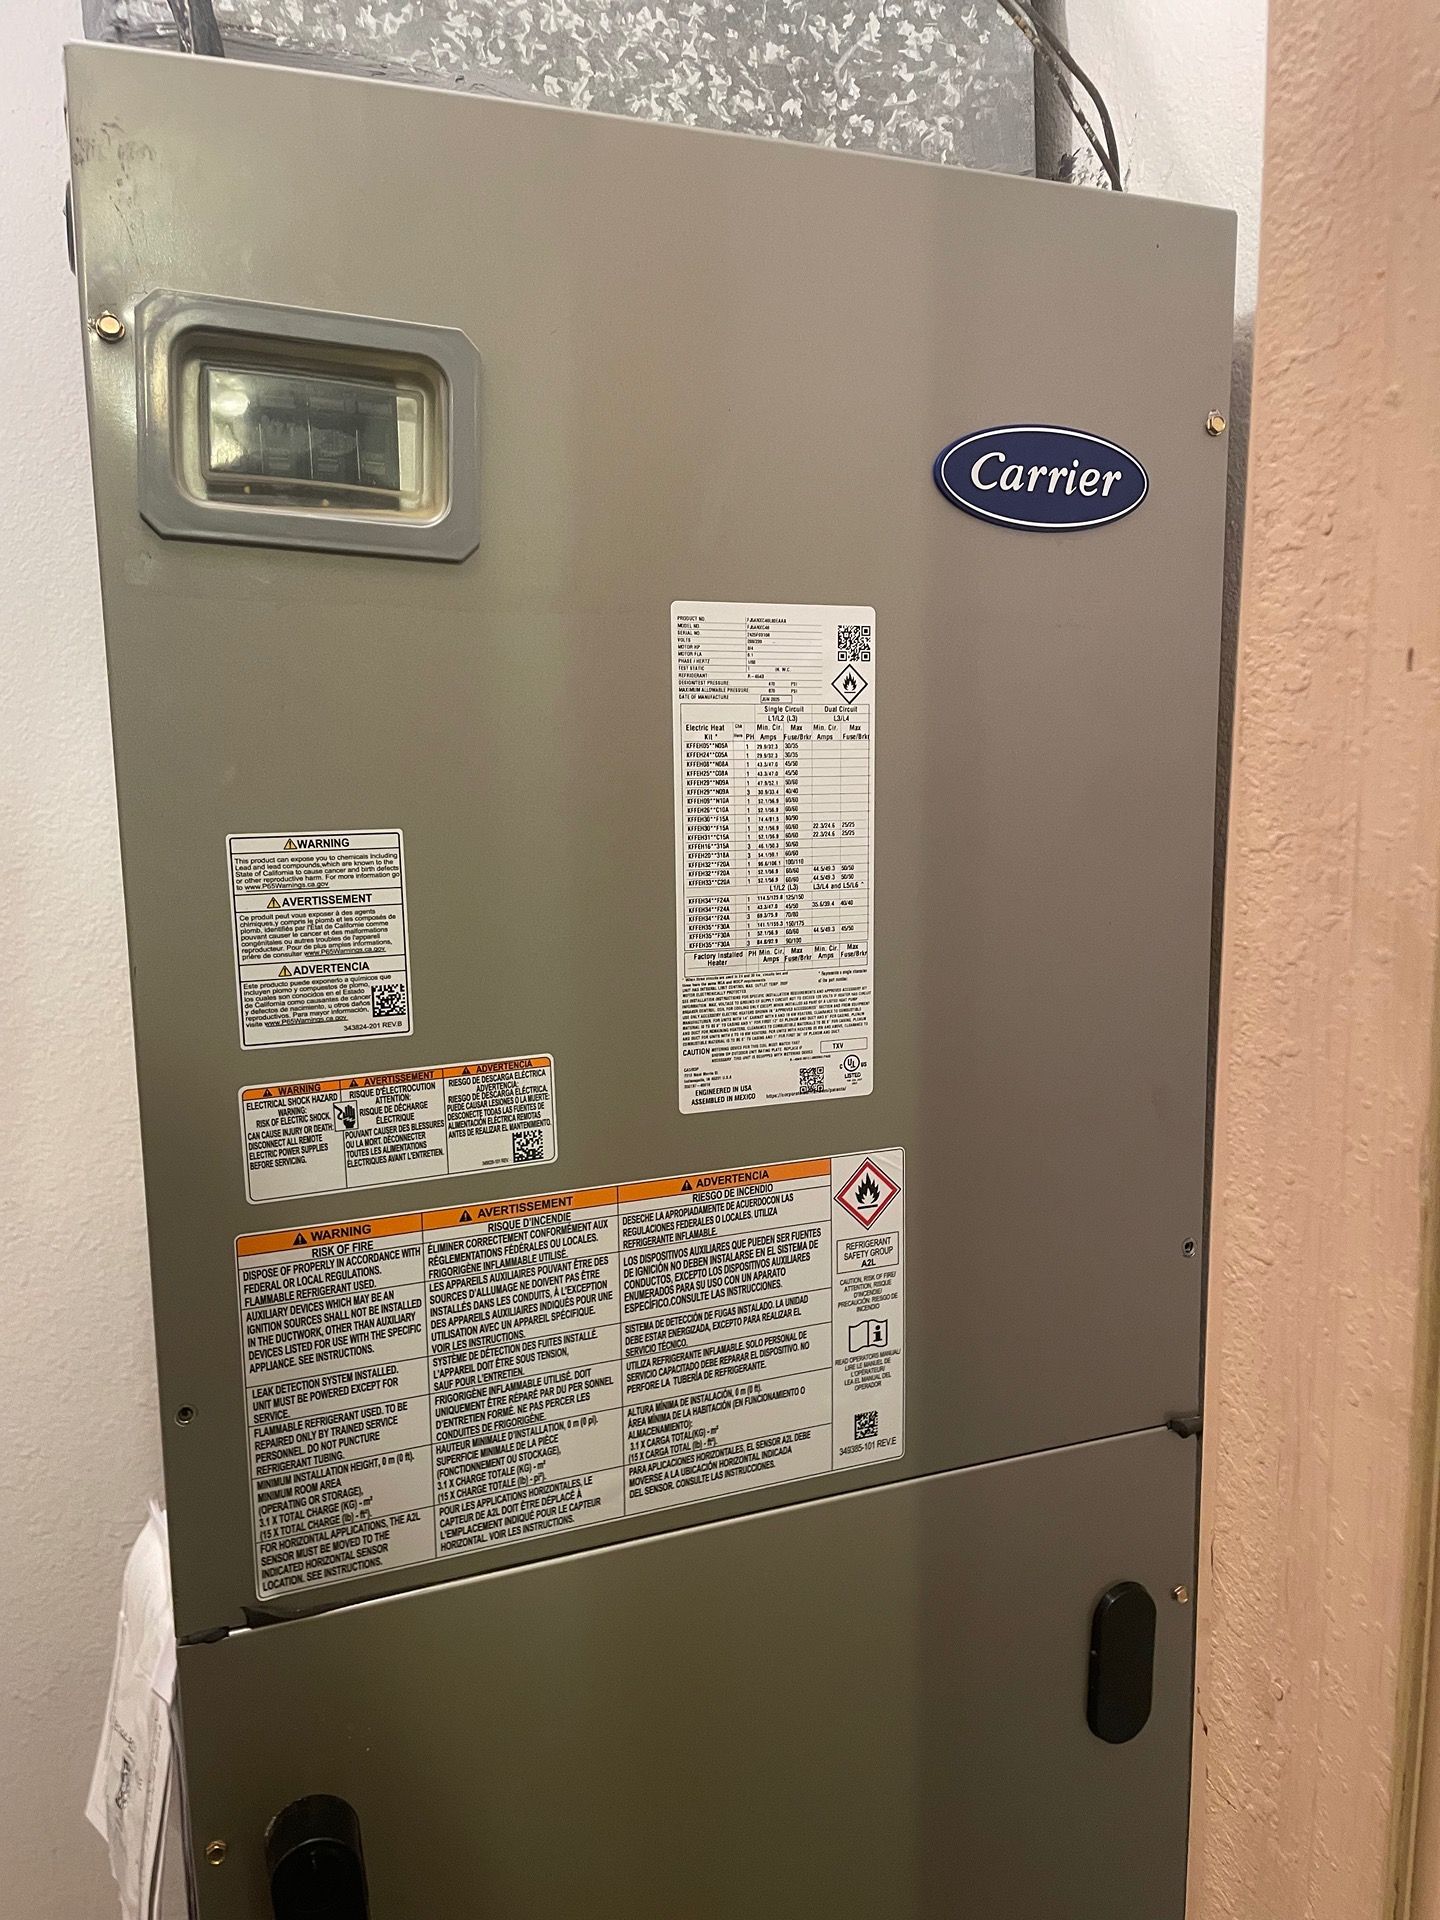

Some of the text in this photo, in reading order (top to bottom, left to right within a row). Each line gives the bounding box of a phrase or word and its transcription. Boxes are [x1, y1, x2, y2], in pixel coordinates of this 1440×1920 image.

[970, 451, 1121, 497] Carrier
[296, 839, 350, 849] WARNING
[234, 857, 249, 865] This
[250, 857, 275, 865] product
[336, 853, 368, 861] chemicals
[369, 852, 398, 861] including
[281, 894, 373, 907] AVERTISSEMENT
[692, 950, 744, 961] Factory Installed
[293, 961, 370, 975] ADVERTENCIA
[682, 1046, 711, 1056] CAUTION
[476, 1060, 533, 1074] ADVERTENCIA
[363, 1070, 435, 1086] AVERTISSEMENT
[448, 1069, 547, 1086] RIESGO DE DESCARGA ELÉCTRICA
[277, 1083, 321, 1095] WARNING
[348, 1081, 436, 1100] RISQUE D'ÉLECTROCUTION
[694, 1084, 753, 1096] ENGINEERED IN USA
[246, 1093, 338, 1110] ELECTRICAL SHOCK HAZARD
[374, 1093, 412, 1104] ATTENTION:
[691, 1095, 725, 1105] ASSEMBLED
[734, 1093, 756, 1101] MEXICO
[277, 1106, 308, 1116] WARNING:
[255, 1119, 270, 1128] RISK
[270, 1118, 279, 1126] OF
[279, 1115, 308, 1125] ELECTRIC
[247, 1131, 260, 1140] CAN
[260, 1129, 281, 1139] CAUSE
[281, 1126, 302, 1136] INJURY
[303, 1125, 312, 1134] OR
[247, 1134, 323, 1150] DISCONNECT ALL REMOTE
[248, 1143, 329, 1160] ELECTRIC POWER SUPPLIES
[249, 1155, 308, 1170] BEFORE SERVICING.
[696, 1170, 770, 1188] ADVERTENCIA
[692, 1183, 774, 1203] RIESGO DE INCENDIO
[477, 1197, 574, 1218] AVERTISSEMENT
[622, 1192, 794, 1225] DESECHE LA APROPIADAMENTE DE ACUERDOCON LAS
[487, 1212, 572, 1234] RISQUE D'INCENDIE
[310, 1224, 372, 1241] WARNING
[427, 1219, 609, 1254] ÉLIMINER CORRECTEMENT CONFORMÉMENT AUX
[623, 1227, 718, 1248] REFRIGERANTE INFLAMABLE.
[311, 1240, 374, 1257] RISK OF FIRE
[427, 1232, 599, 1266] RÉGLEMENTATIONS FÉDÉRALES OU LOCALES.
[843, 1245, 894, 1260] SAFETY GROUP
[845, 1237, 892, 1251] REFRIGERANT
[243, 1247, 422, 1281] DISPOSE OF PROPERLY IN ACCORDANCE WITH
[860, 1258, 877, 1268] A2L
[244, 1265, 382, 1294] FEDERAL OR LOCAL REGULATIONS.
[244, 1279, 376, 1307] FLAMMABLE REFRIGERANT USED.
[246, 1290, 394, 1322] AUXILIARY DEVICES WHICH MAY BE AN
[247, 1298, 422, 1335] IGNITION SOURCES SHALL NOT BE INSTALLED
[251, 1364, 399, 1399] LEAK DETECTION SYSTEM INSTALLED.
